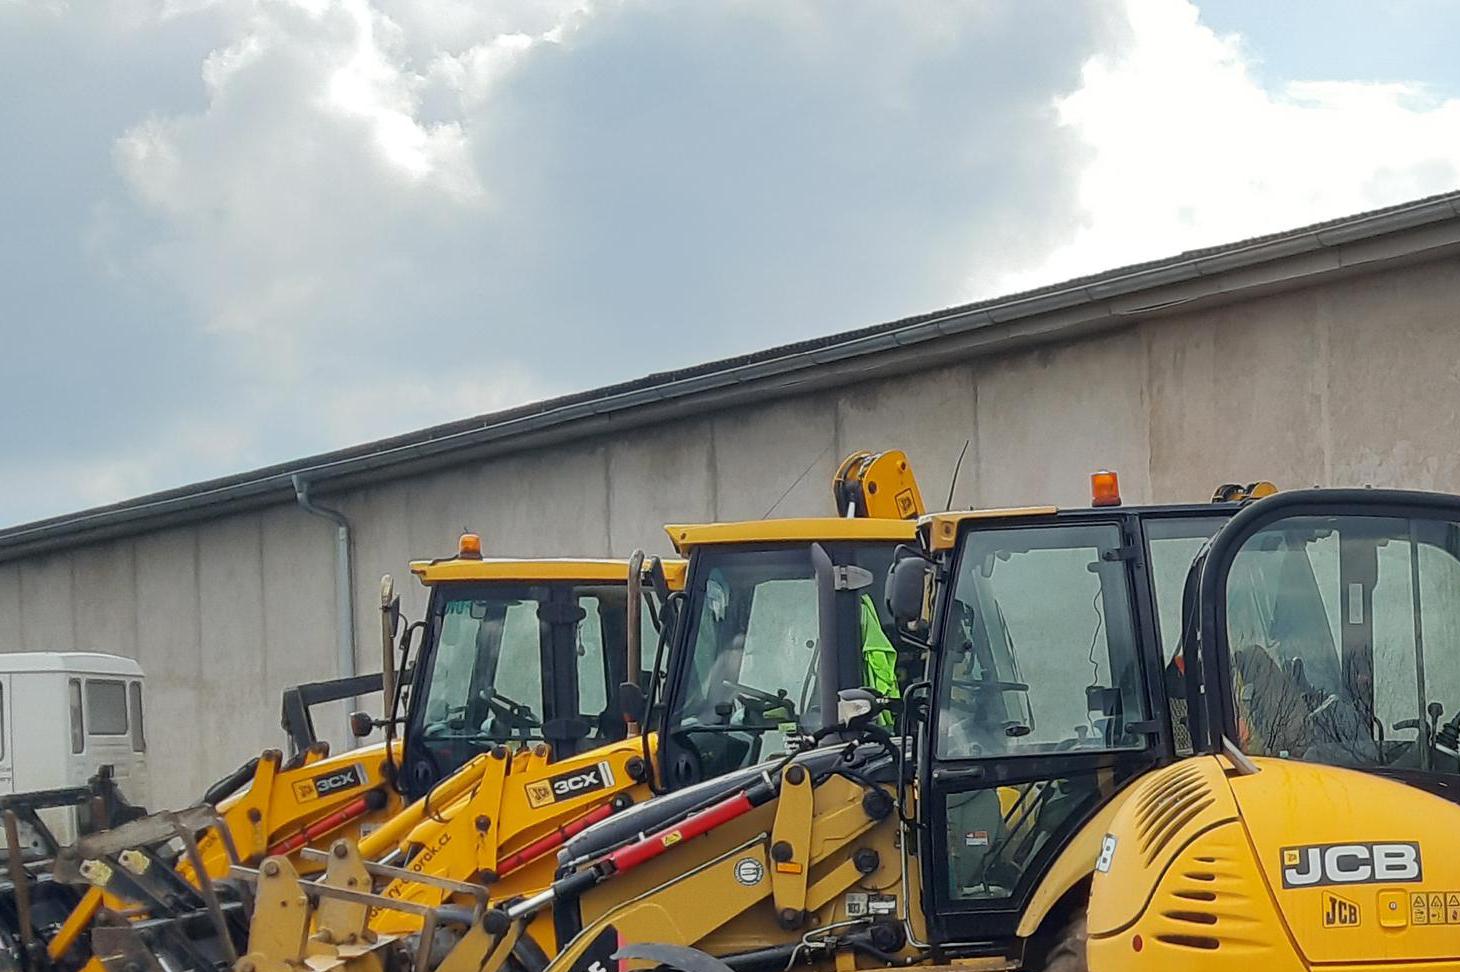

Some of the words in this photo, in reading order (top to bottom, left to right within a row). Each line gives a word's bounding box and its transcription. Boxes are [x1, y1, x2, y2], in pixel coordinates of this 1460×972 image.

[316, 771, 354, 792] 3CX
[553, 771, 599, 795] 3CX
[1284, 844, 1419, 885] JCB
[1326, 896, 1358, 925] JCB
